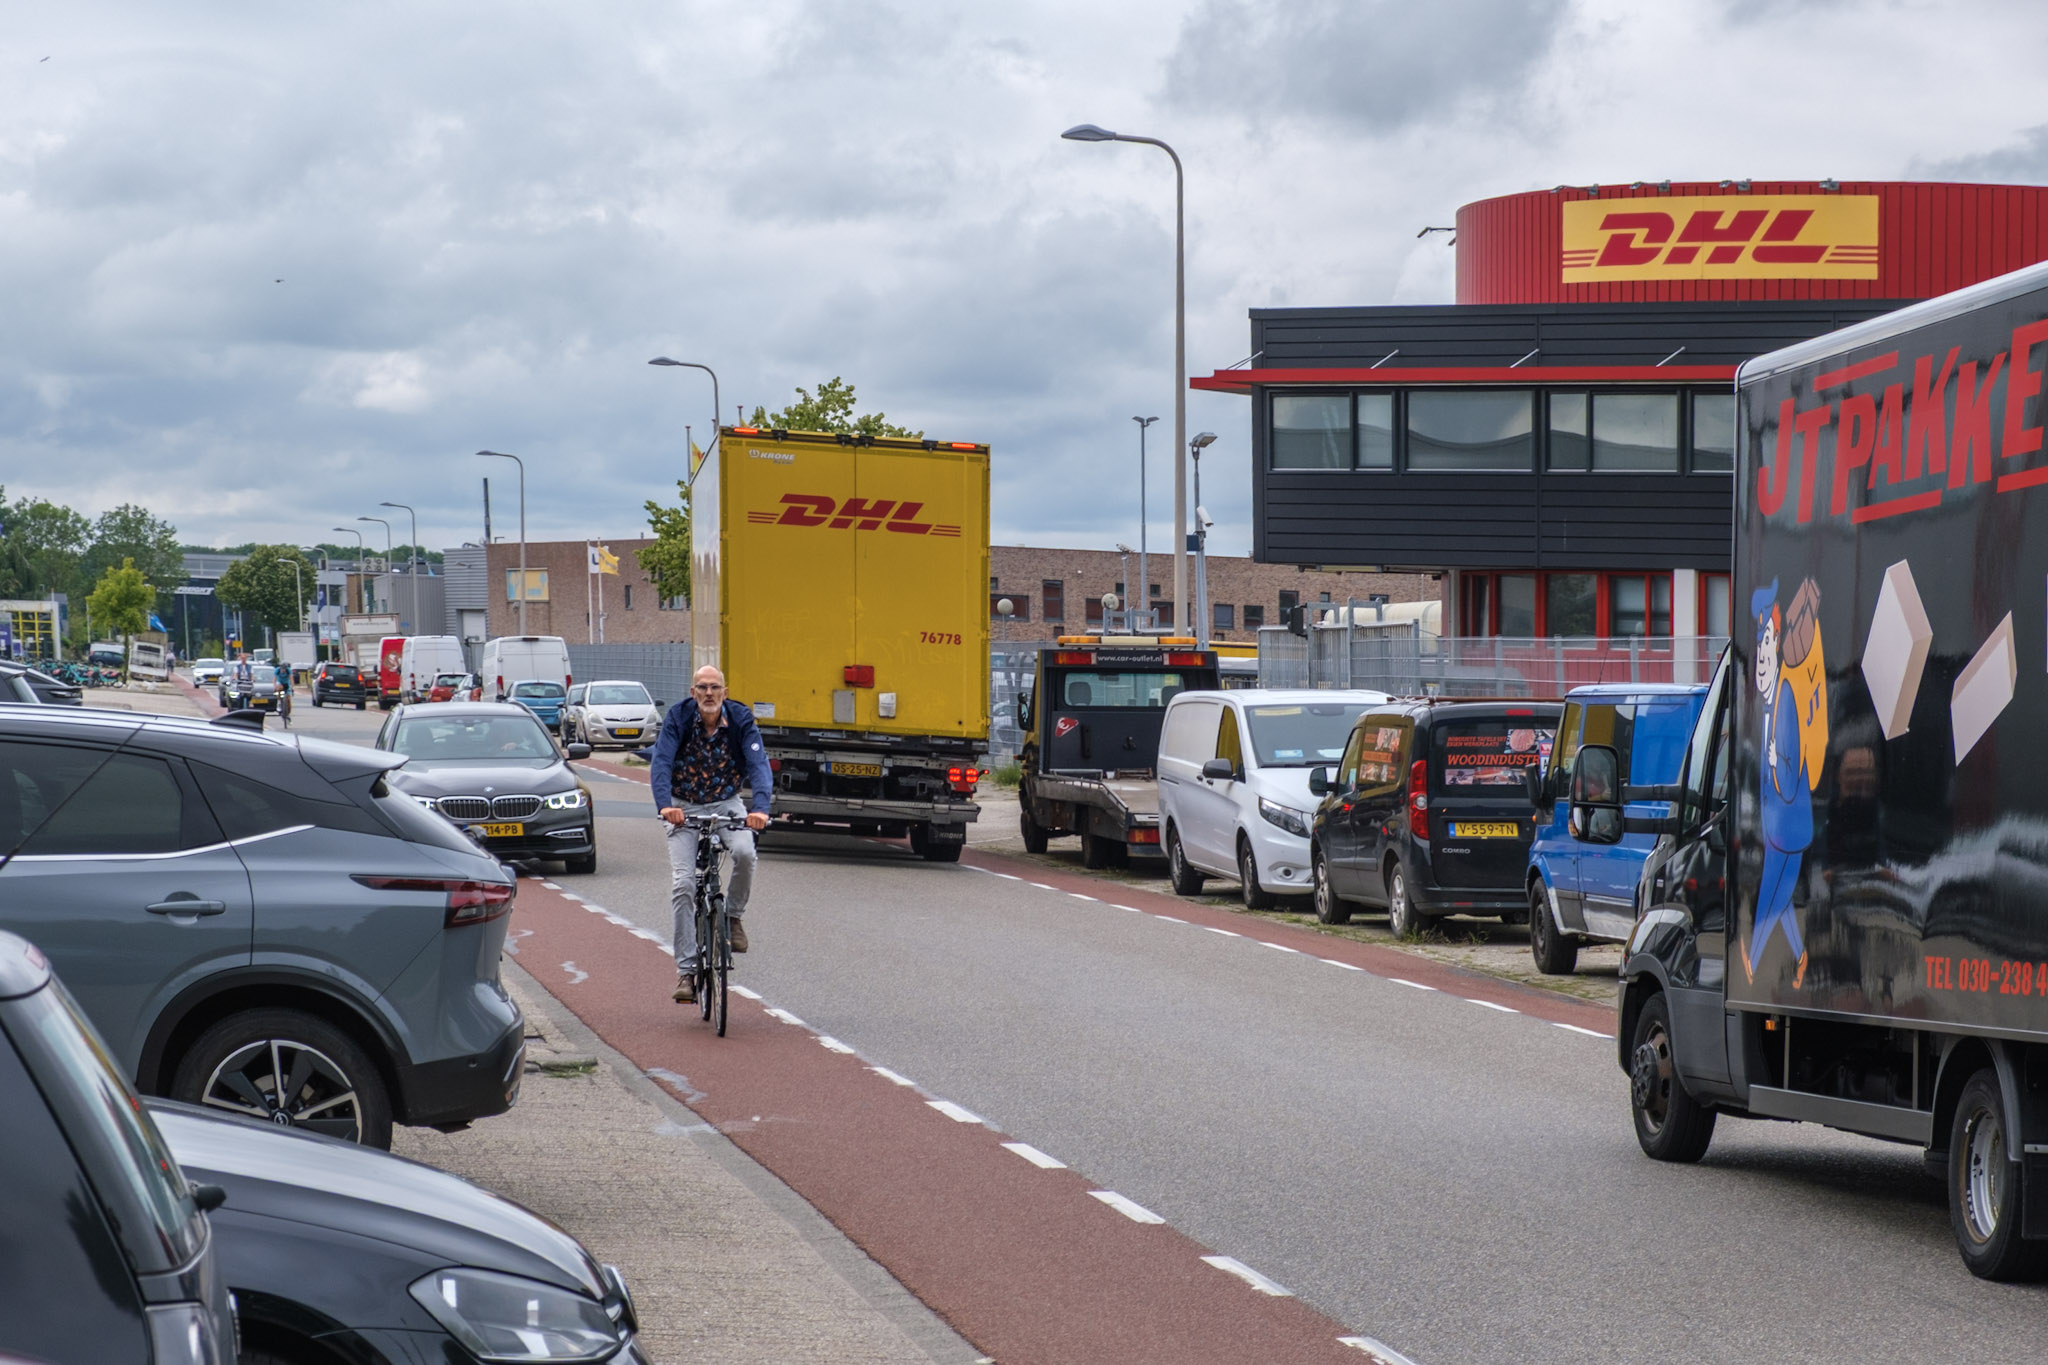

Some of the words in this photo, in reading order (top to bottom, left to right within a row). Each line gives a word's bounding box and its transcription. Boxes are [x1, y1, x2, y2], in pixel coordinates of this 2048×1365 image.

[1595, 209, 1830, 267] DHL
[760, 452, 795, 461] KRONE
[776, 493, 933, 535] DHL
[920, 631, 962, 645] 76778
[1097, 654, 1162, 662] www.car-outlet.nl
[1459, 824, 1514, 835] V-559-TN
[1924, 956, 1953, 990] TEL
[1959, 958, 2033, 996] 030-238
[2035, 963, 2048, 997] 4
